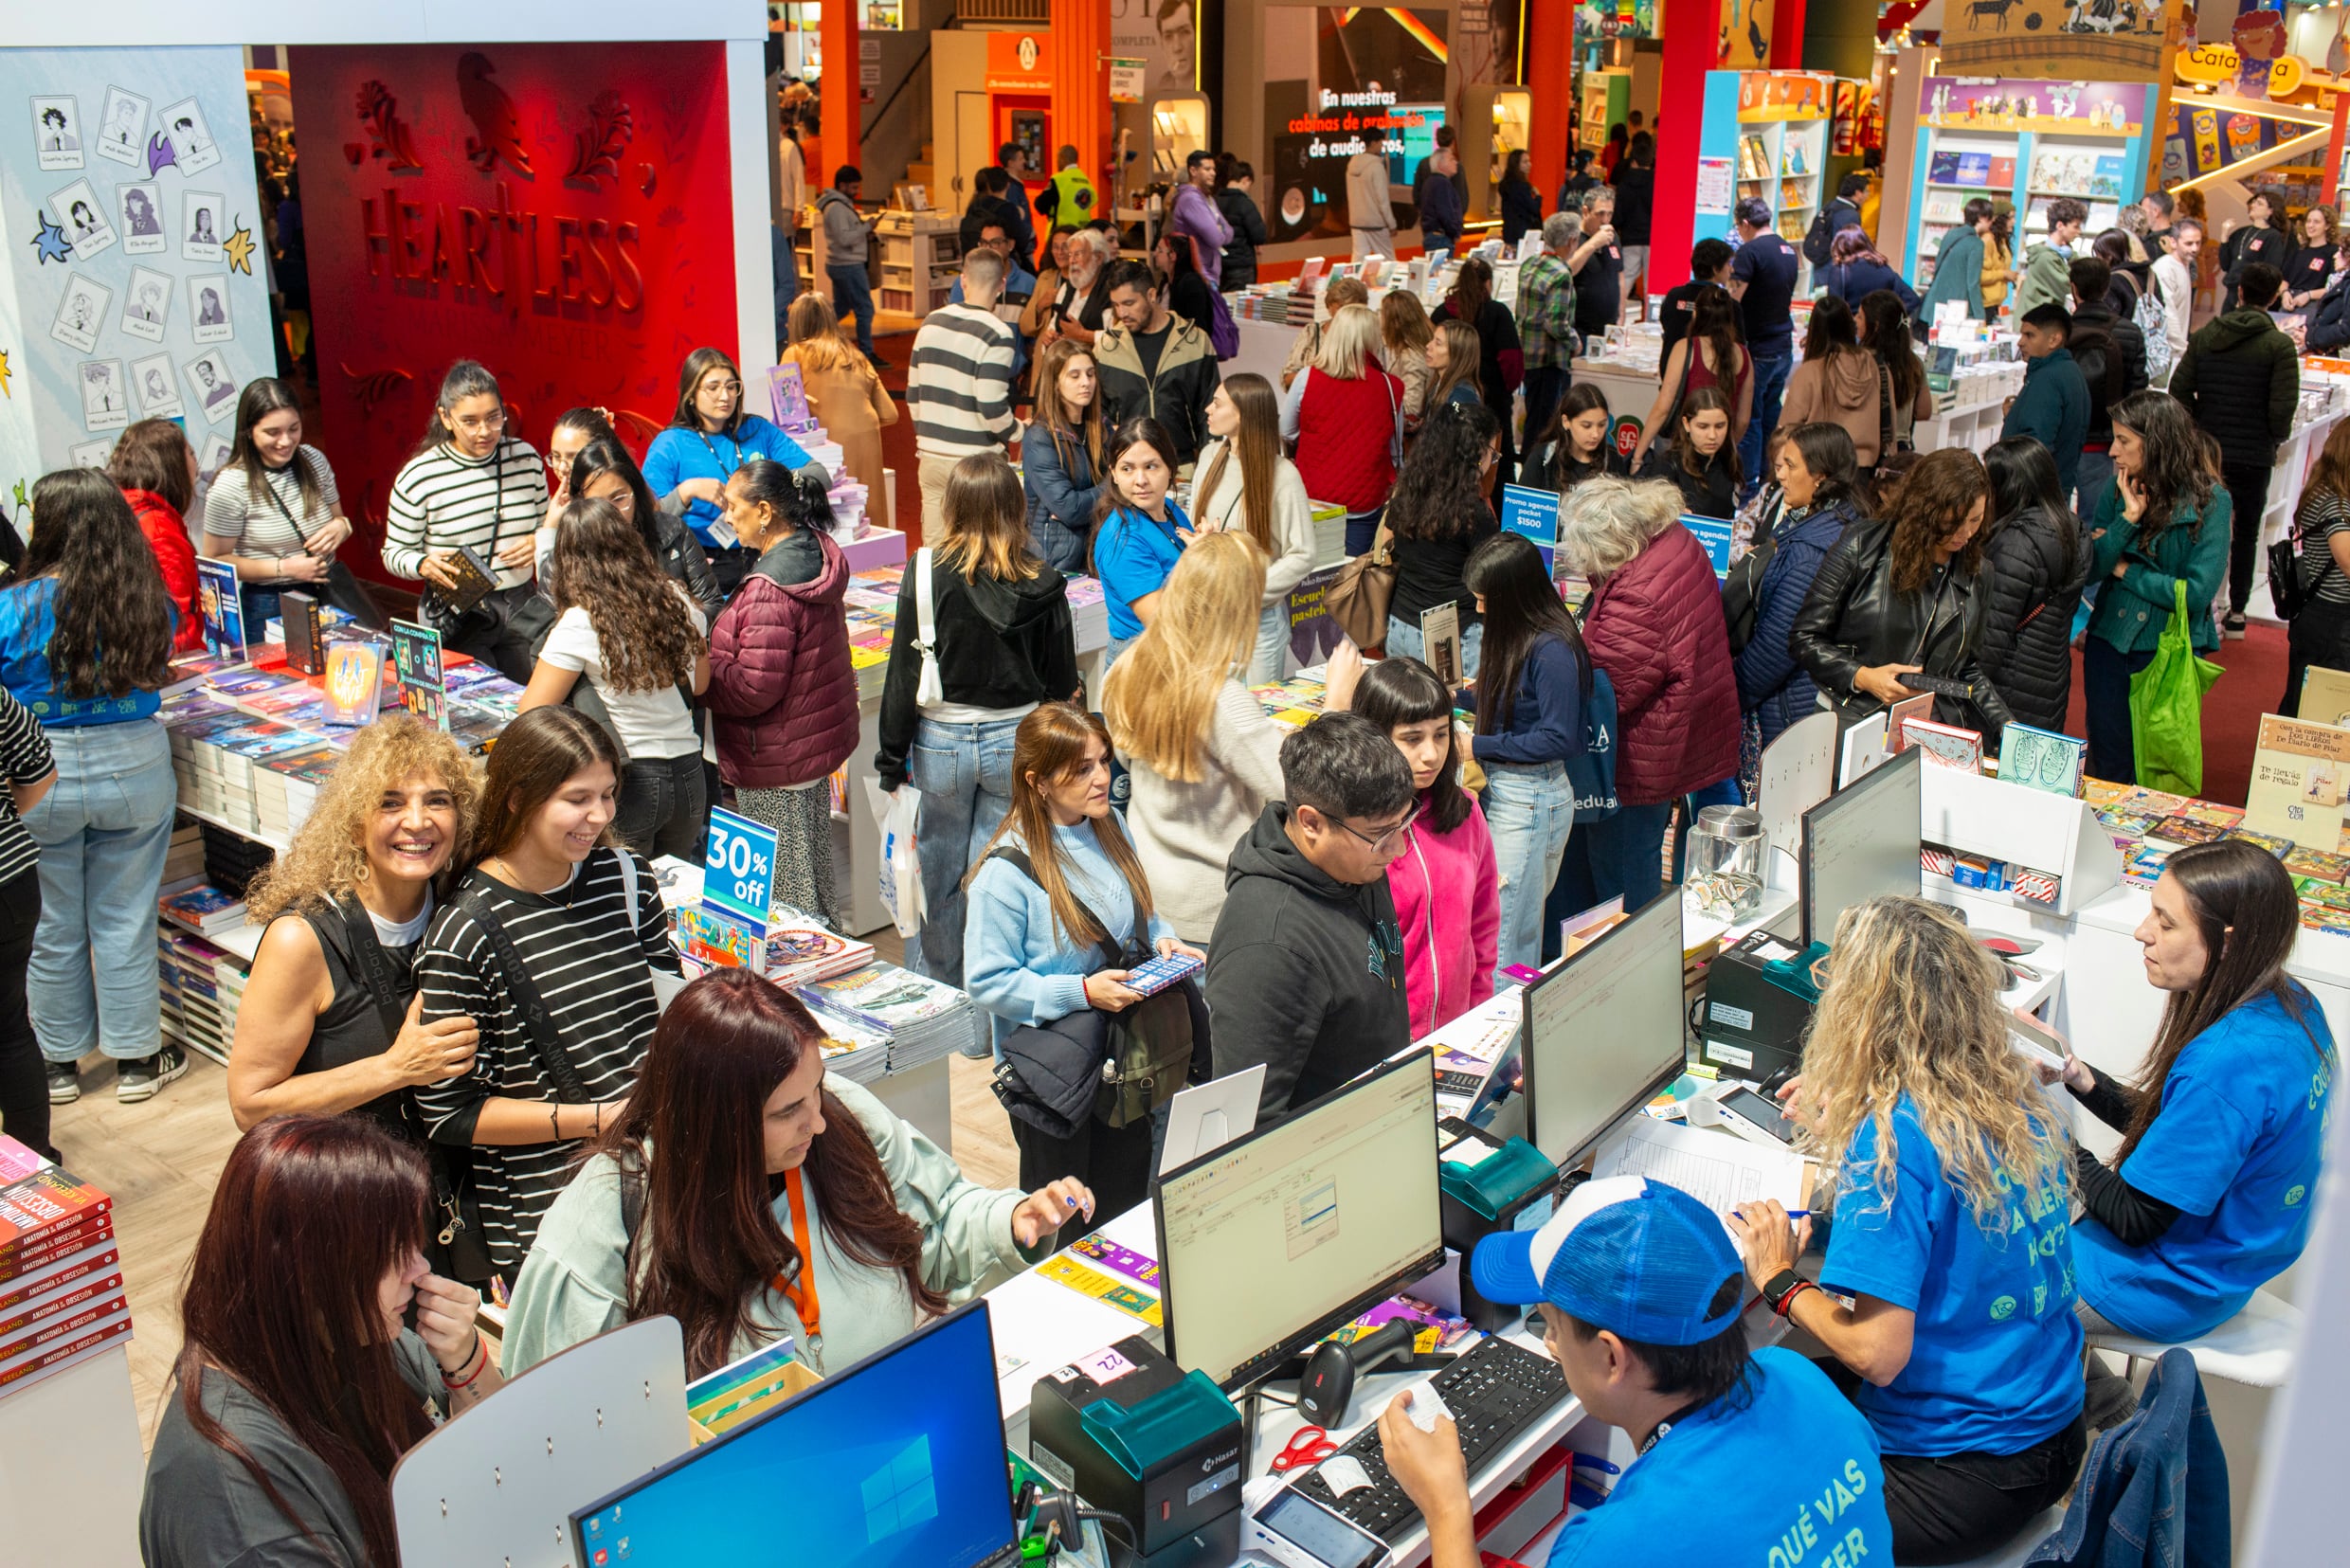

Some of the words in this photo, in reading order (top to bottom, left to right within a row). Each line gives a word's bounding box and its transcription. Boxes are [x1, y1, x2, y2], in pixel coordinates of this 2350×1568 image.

[2190, 46, 2288, 76] Cataa
[1322, 88, 1339, 107] En
[1341, 90, 1397, 106] nuestras
[1289, 113, 1340, 133] cabinas
[1343, 111, 1360, 130] de
[1309, 137, 1327, 157] de
[1329, 135, 1405, 156] audioros,
[362, 181, 643, 313] HEARTLESS
[1505, 496, 1528, 507] Promo
[1528, 501, 1557, 513] agendas
[1518, 508, 1542, 518] pocket
[1516, 516, 1542, 529] $1500
[1291, 586, 1327, 608] Escuel
[334, 664, 369, 683] HEAT
[2259, 773, 2270, 782] de
[2271, 775, 2299, 787] regalo
[2260, 766, 2271, 774] Te
[707, 826, 768, 877] 30%
[734, 880, 766, 907] off
[542, 1039, 583, 1102] OMPANY
[37, 1175, 79, 1199] KEELAND
[1215, 1447, 1239, 1465] Hasar
[1814, 1458, 1867, 1525] VAS
